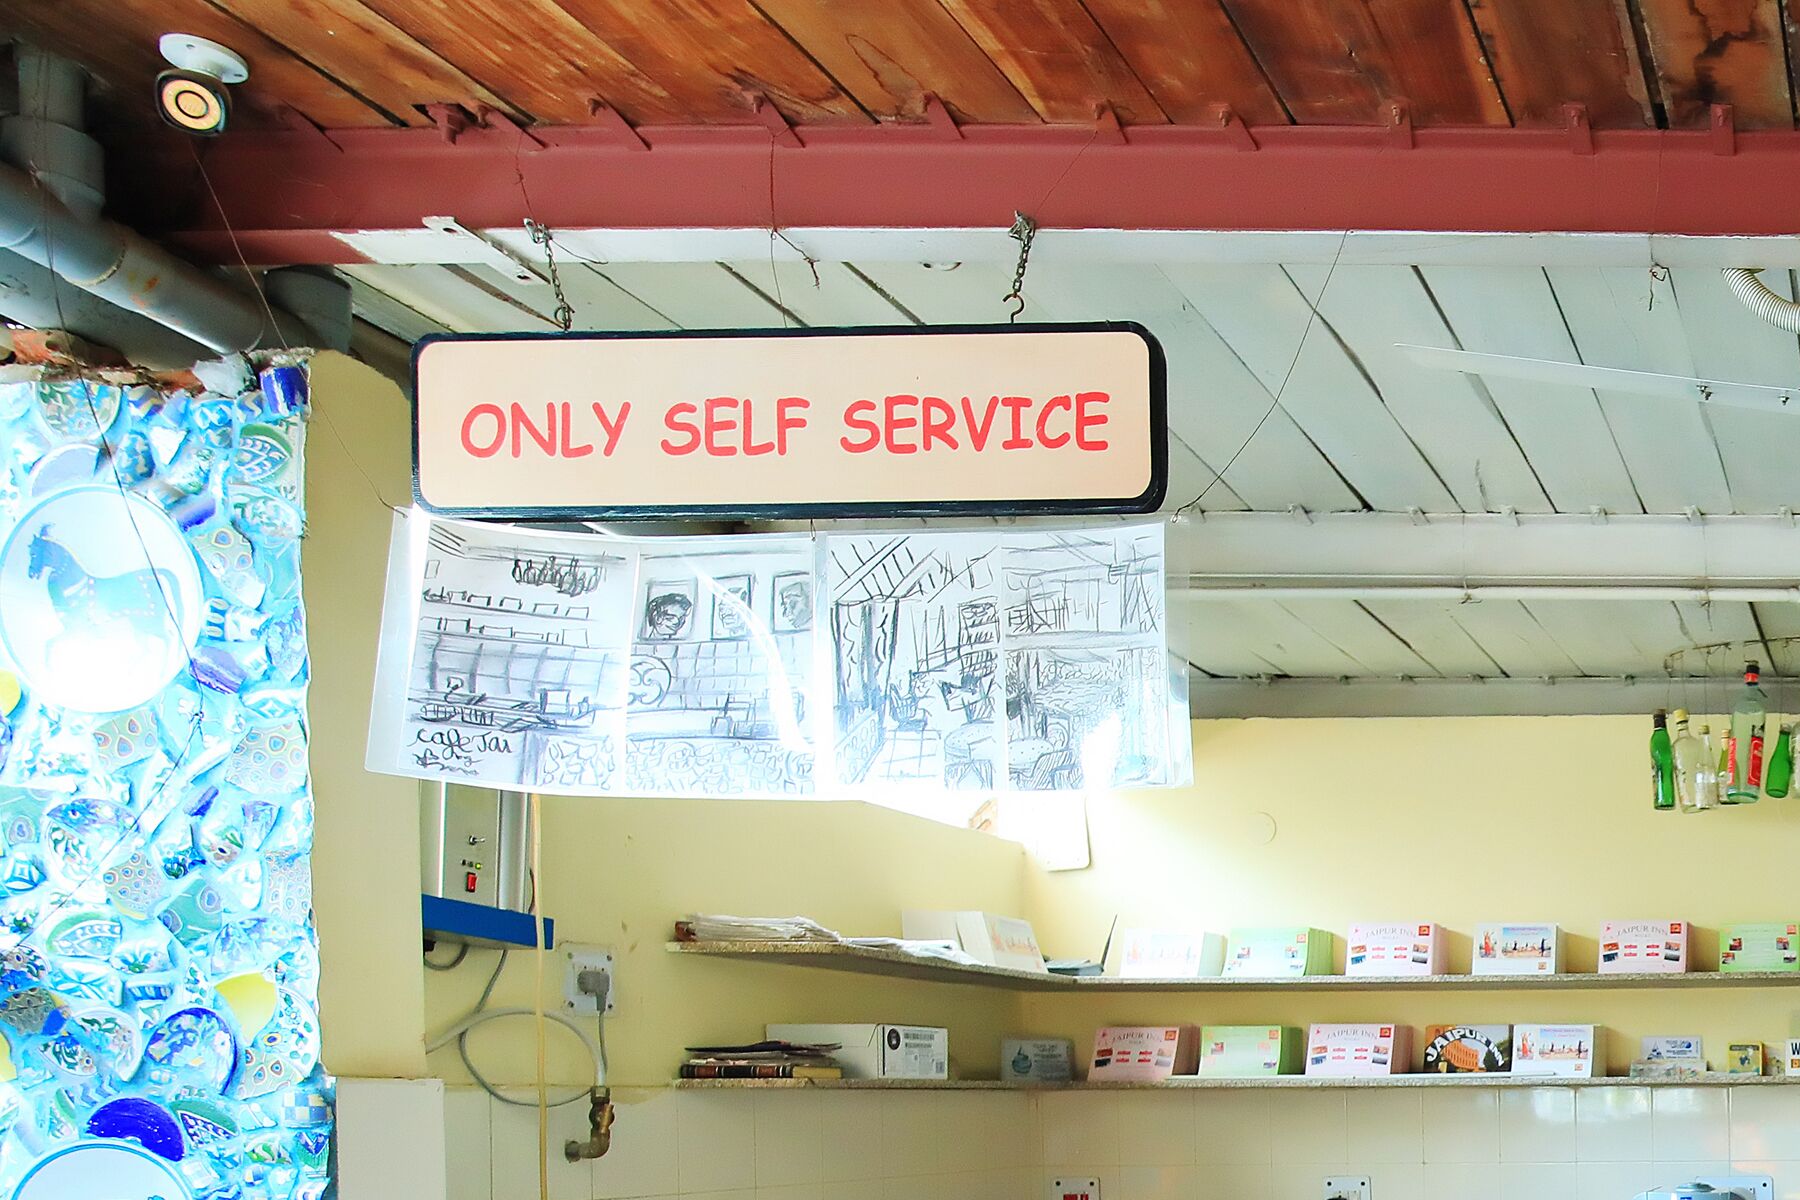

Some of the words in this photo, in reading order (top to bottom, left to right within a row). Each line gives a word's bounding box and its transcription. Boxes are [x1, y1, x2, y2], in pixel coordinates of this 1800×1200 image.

[460, 399, 632, 459] ONLY
[659, 395, 811, 457] SELF
[839, 390, 1111, 454] SERVICE
[1425, 1028, 1488, 1063] JAIPUR
[1488, 1040, 1505, 1067] INN
